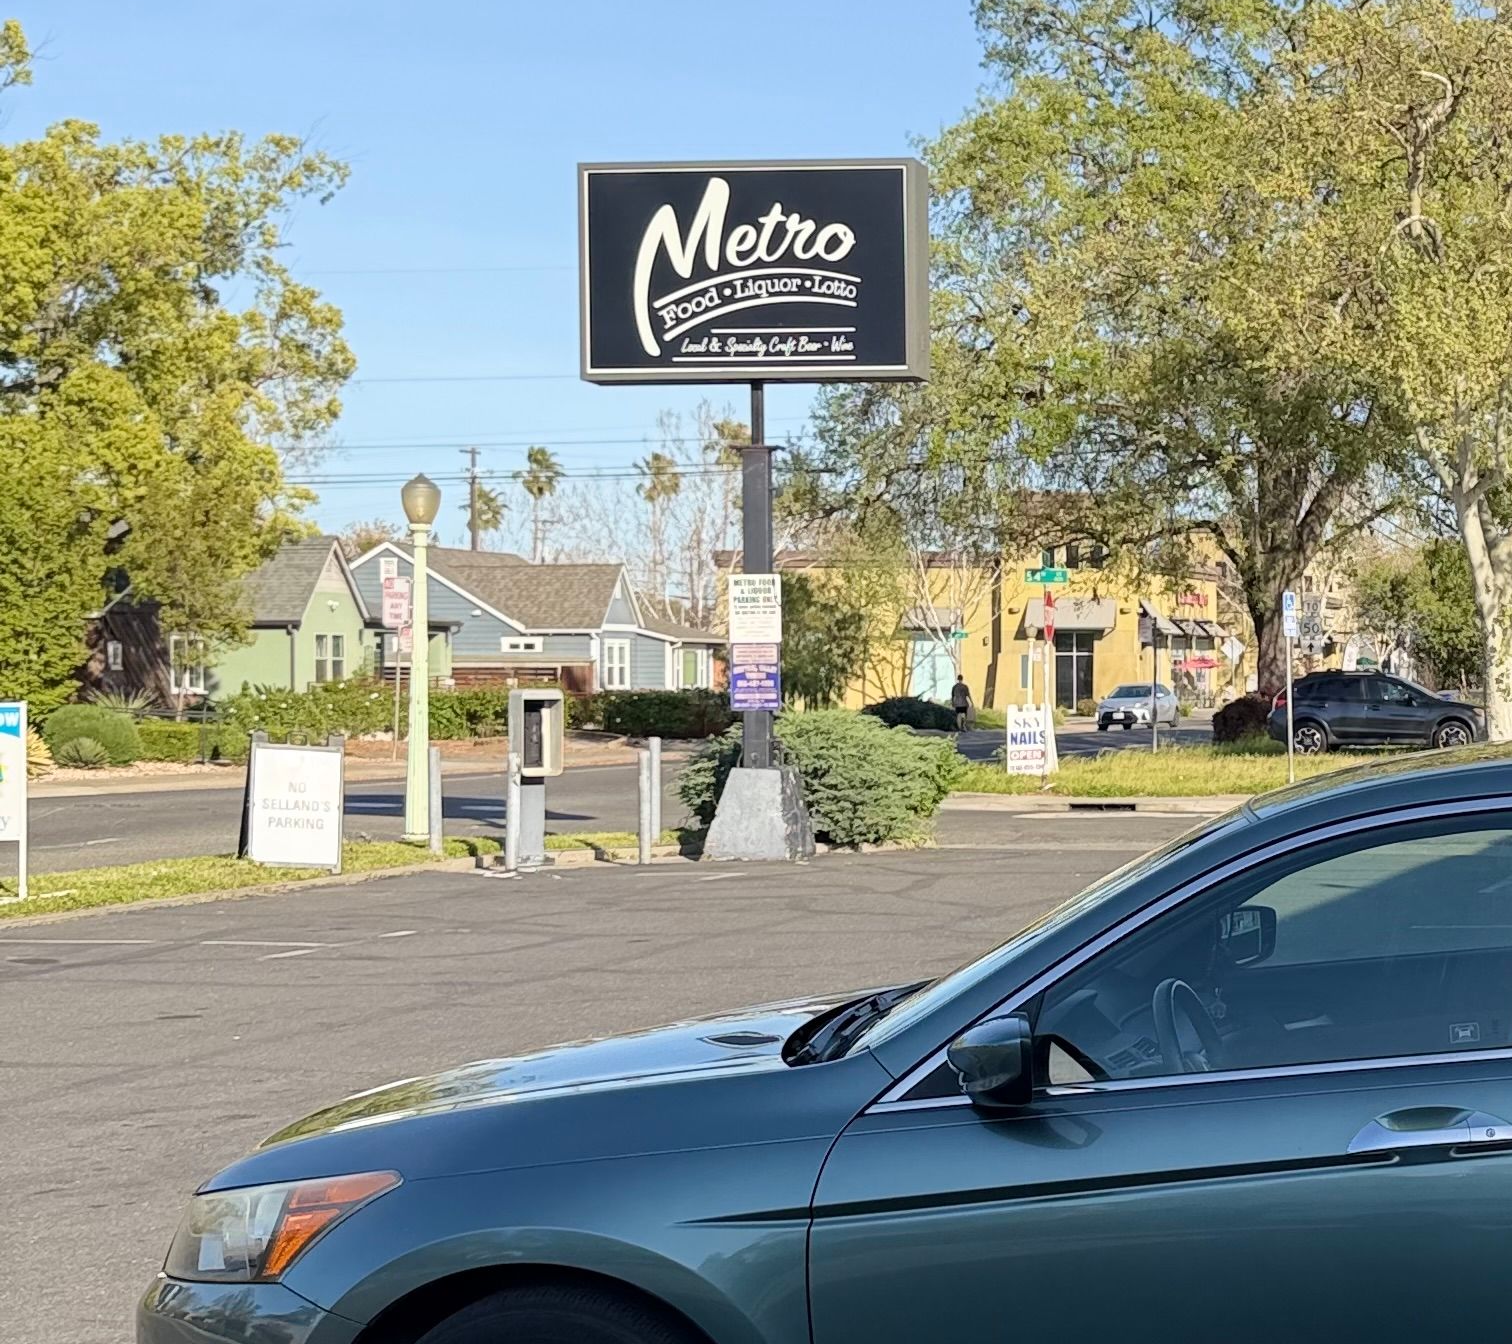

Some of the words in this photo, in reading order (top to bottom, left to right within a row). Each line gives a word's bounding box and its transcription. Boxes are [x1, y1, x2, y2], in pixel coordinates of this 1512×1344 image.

[634, 177, 856, 357] Metro
[657, 289, 722, 329] Food
[732, 277, 801, 299] Liquor
[811, 275, 858, 299] Lotto
[681, 337, 709, 353] Local
[709, 337, 723, 353] &
[724, 336, 768, 357] Specialty
[768, 336, 797, 357] Craft
[798, 336, 823, 353] Beer
[831, 335, 854, 353] Wine
[1303, 622, 1319, 634] 50
[1014, 717, 1041, 728] SKY
[1010, 730, 1046, 745] NAILS
[1010, 750, 1042, 761] OPEN
[288, 781, 307, 794] NO
[262, 798, 332, 813] SELLAND'S
[268, 816, 325, 830] PARKING
